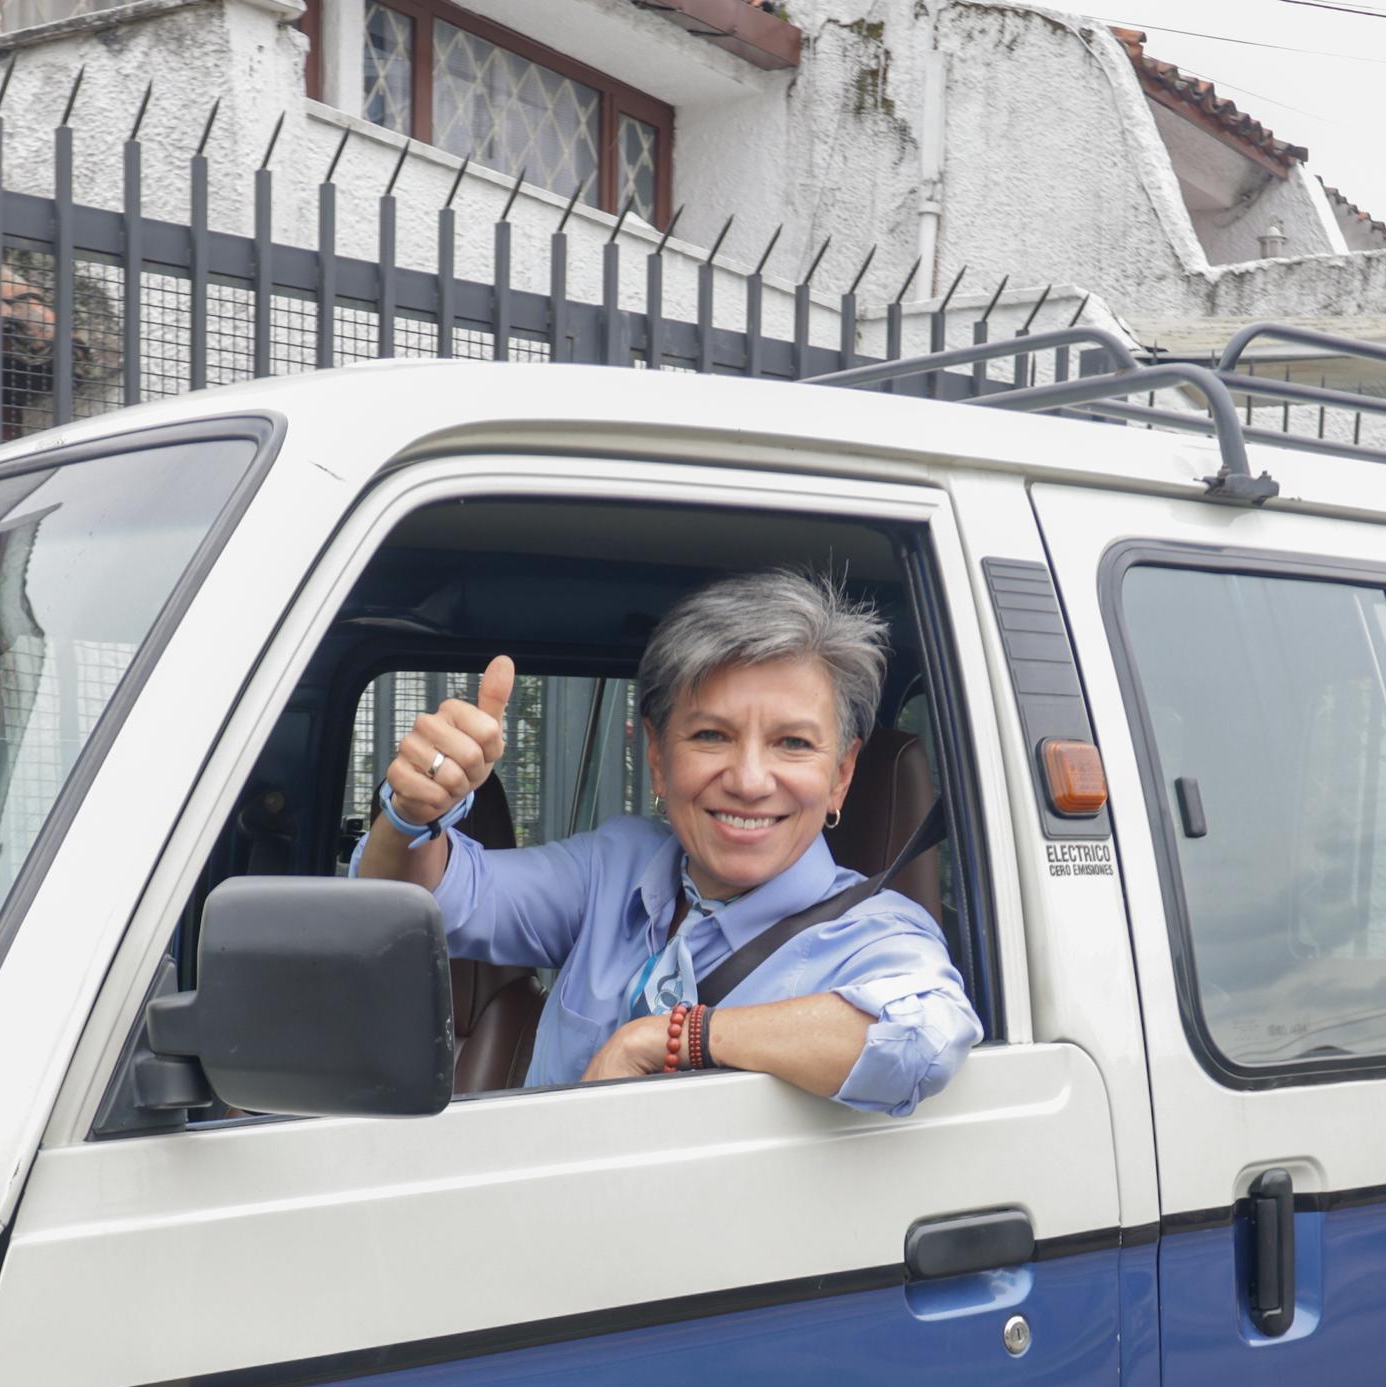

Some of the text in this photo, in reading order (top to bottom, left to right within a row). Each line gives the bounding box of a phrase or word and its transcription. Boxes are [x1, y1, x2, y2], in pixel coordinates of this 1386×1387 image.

[1046, 845, 1111, 862] ELECTRICO
[1050, 865, 1113, 876] CERO EMISIONES
